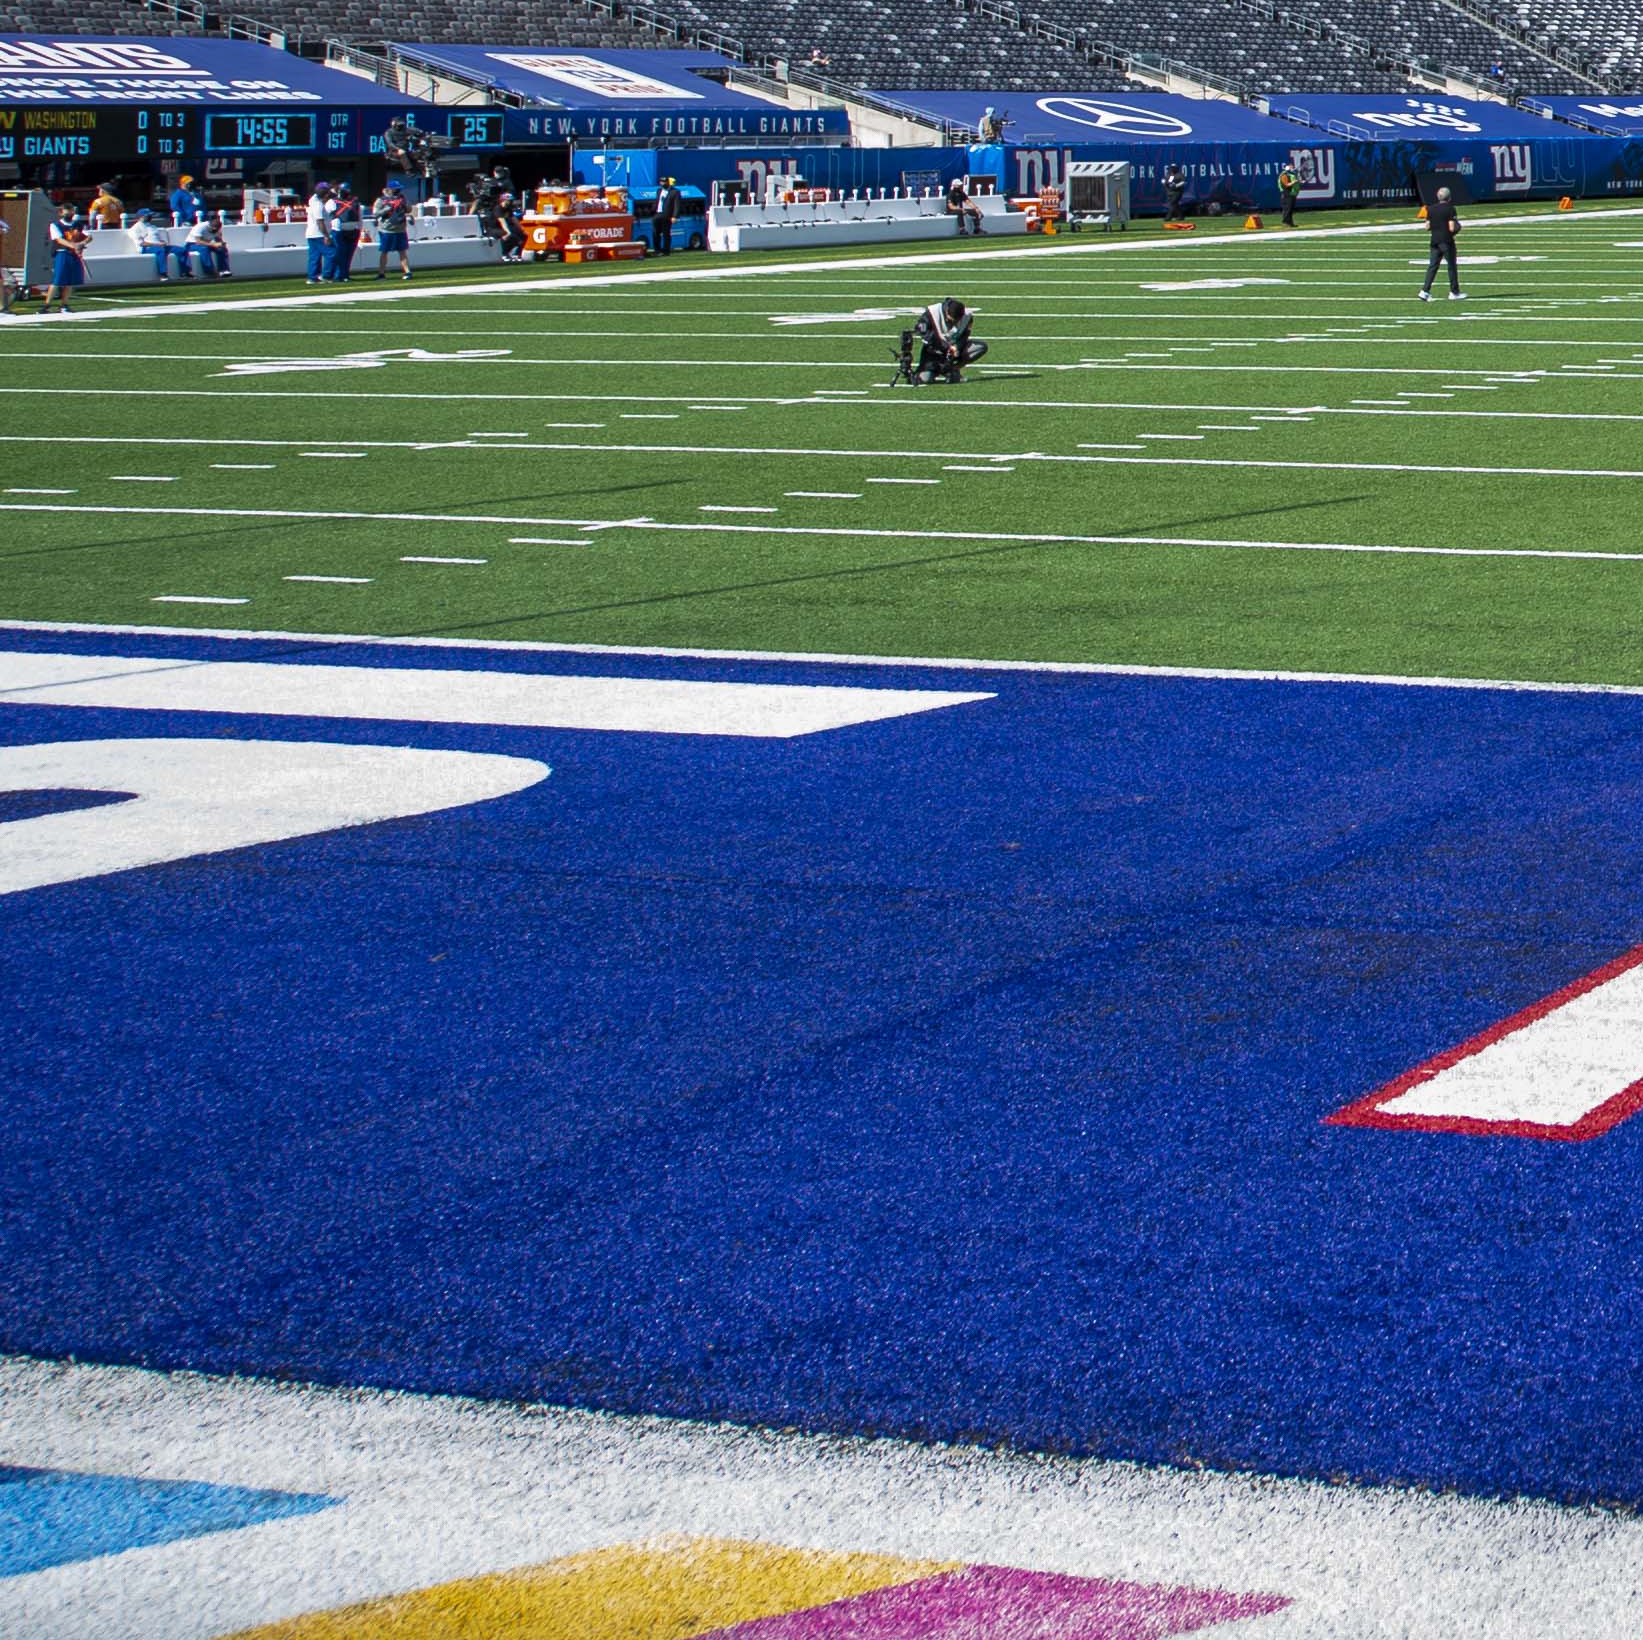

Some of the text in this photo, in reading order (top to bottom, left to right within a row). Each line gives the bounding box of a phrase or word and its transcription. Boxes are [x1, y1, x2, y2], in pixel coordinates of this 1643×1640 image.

[94, 79, 230, 90] THOSE
[71, 90, 323, 100] FRONT LINES
[24, 112, 184, 129] WASHINGTON 0 TO 3
[331, 114, 348, 125] QTR
[530, 117, 825, 135] NEW YORK FOOTBALL GIANTS
[1352, 113, 1482, 132] nrg
[236, 118, 287, 144] 14:55
[464, 118, 487, 142] 25
[24, 136, 184, 156] GIANTS 0 TO 3
[327, 133, 347, 148] 1ST
[1491, 144, 1530, 190] ny
[533, 228, 545, 243] G
